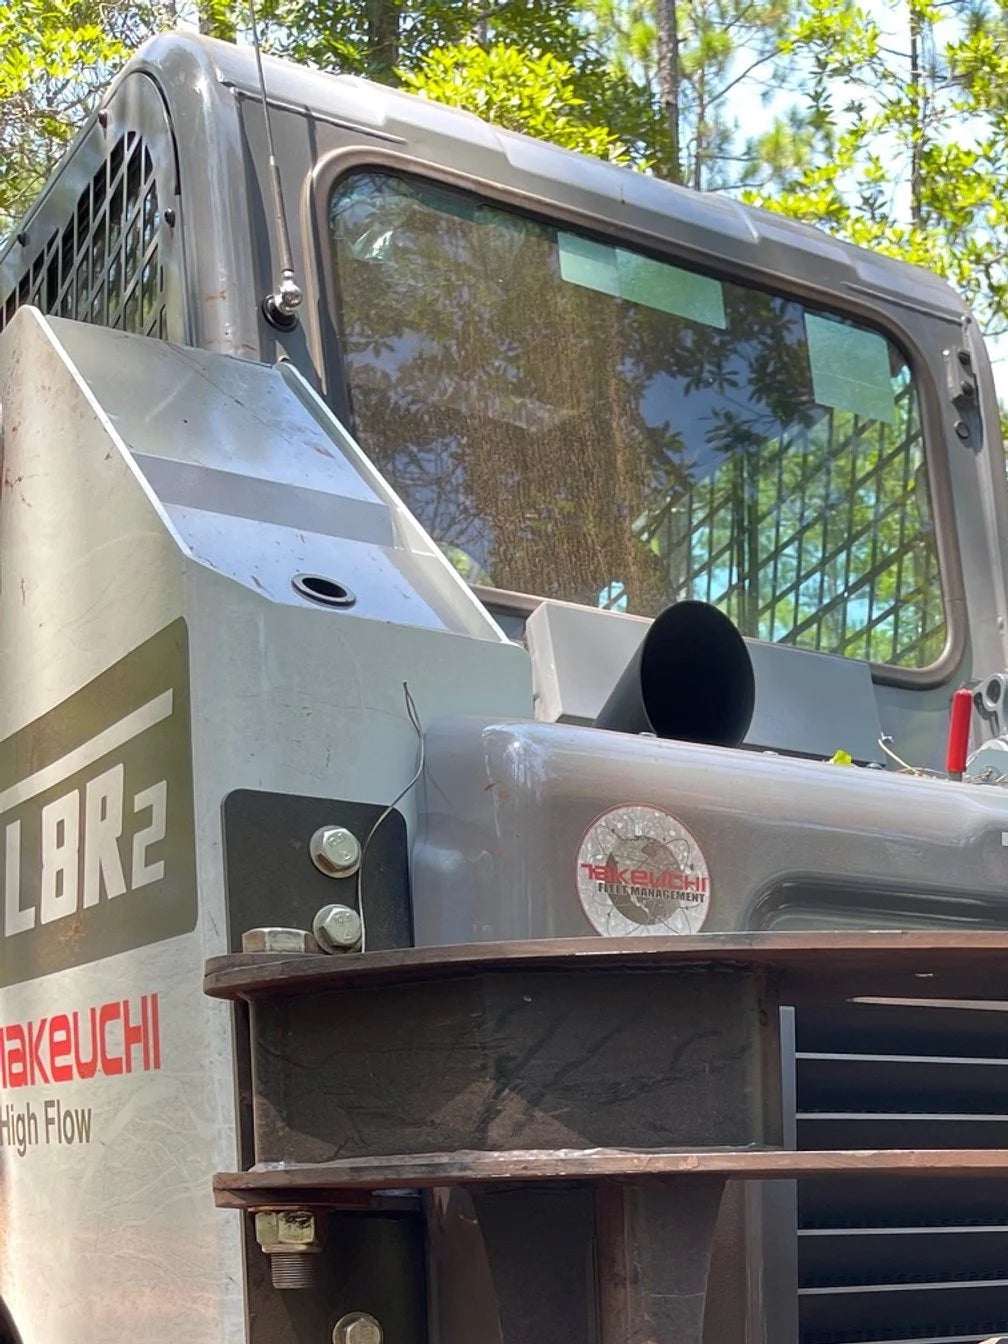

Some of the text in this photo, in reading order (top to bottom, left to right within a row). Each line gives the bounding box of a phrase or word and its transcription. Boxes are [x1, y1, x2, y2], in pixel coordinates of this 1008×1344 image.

[598, 882, 705, 903] FLEET MANAGEMENT
[0, 1099, 92, 1157] High Flow
